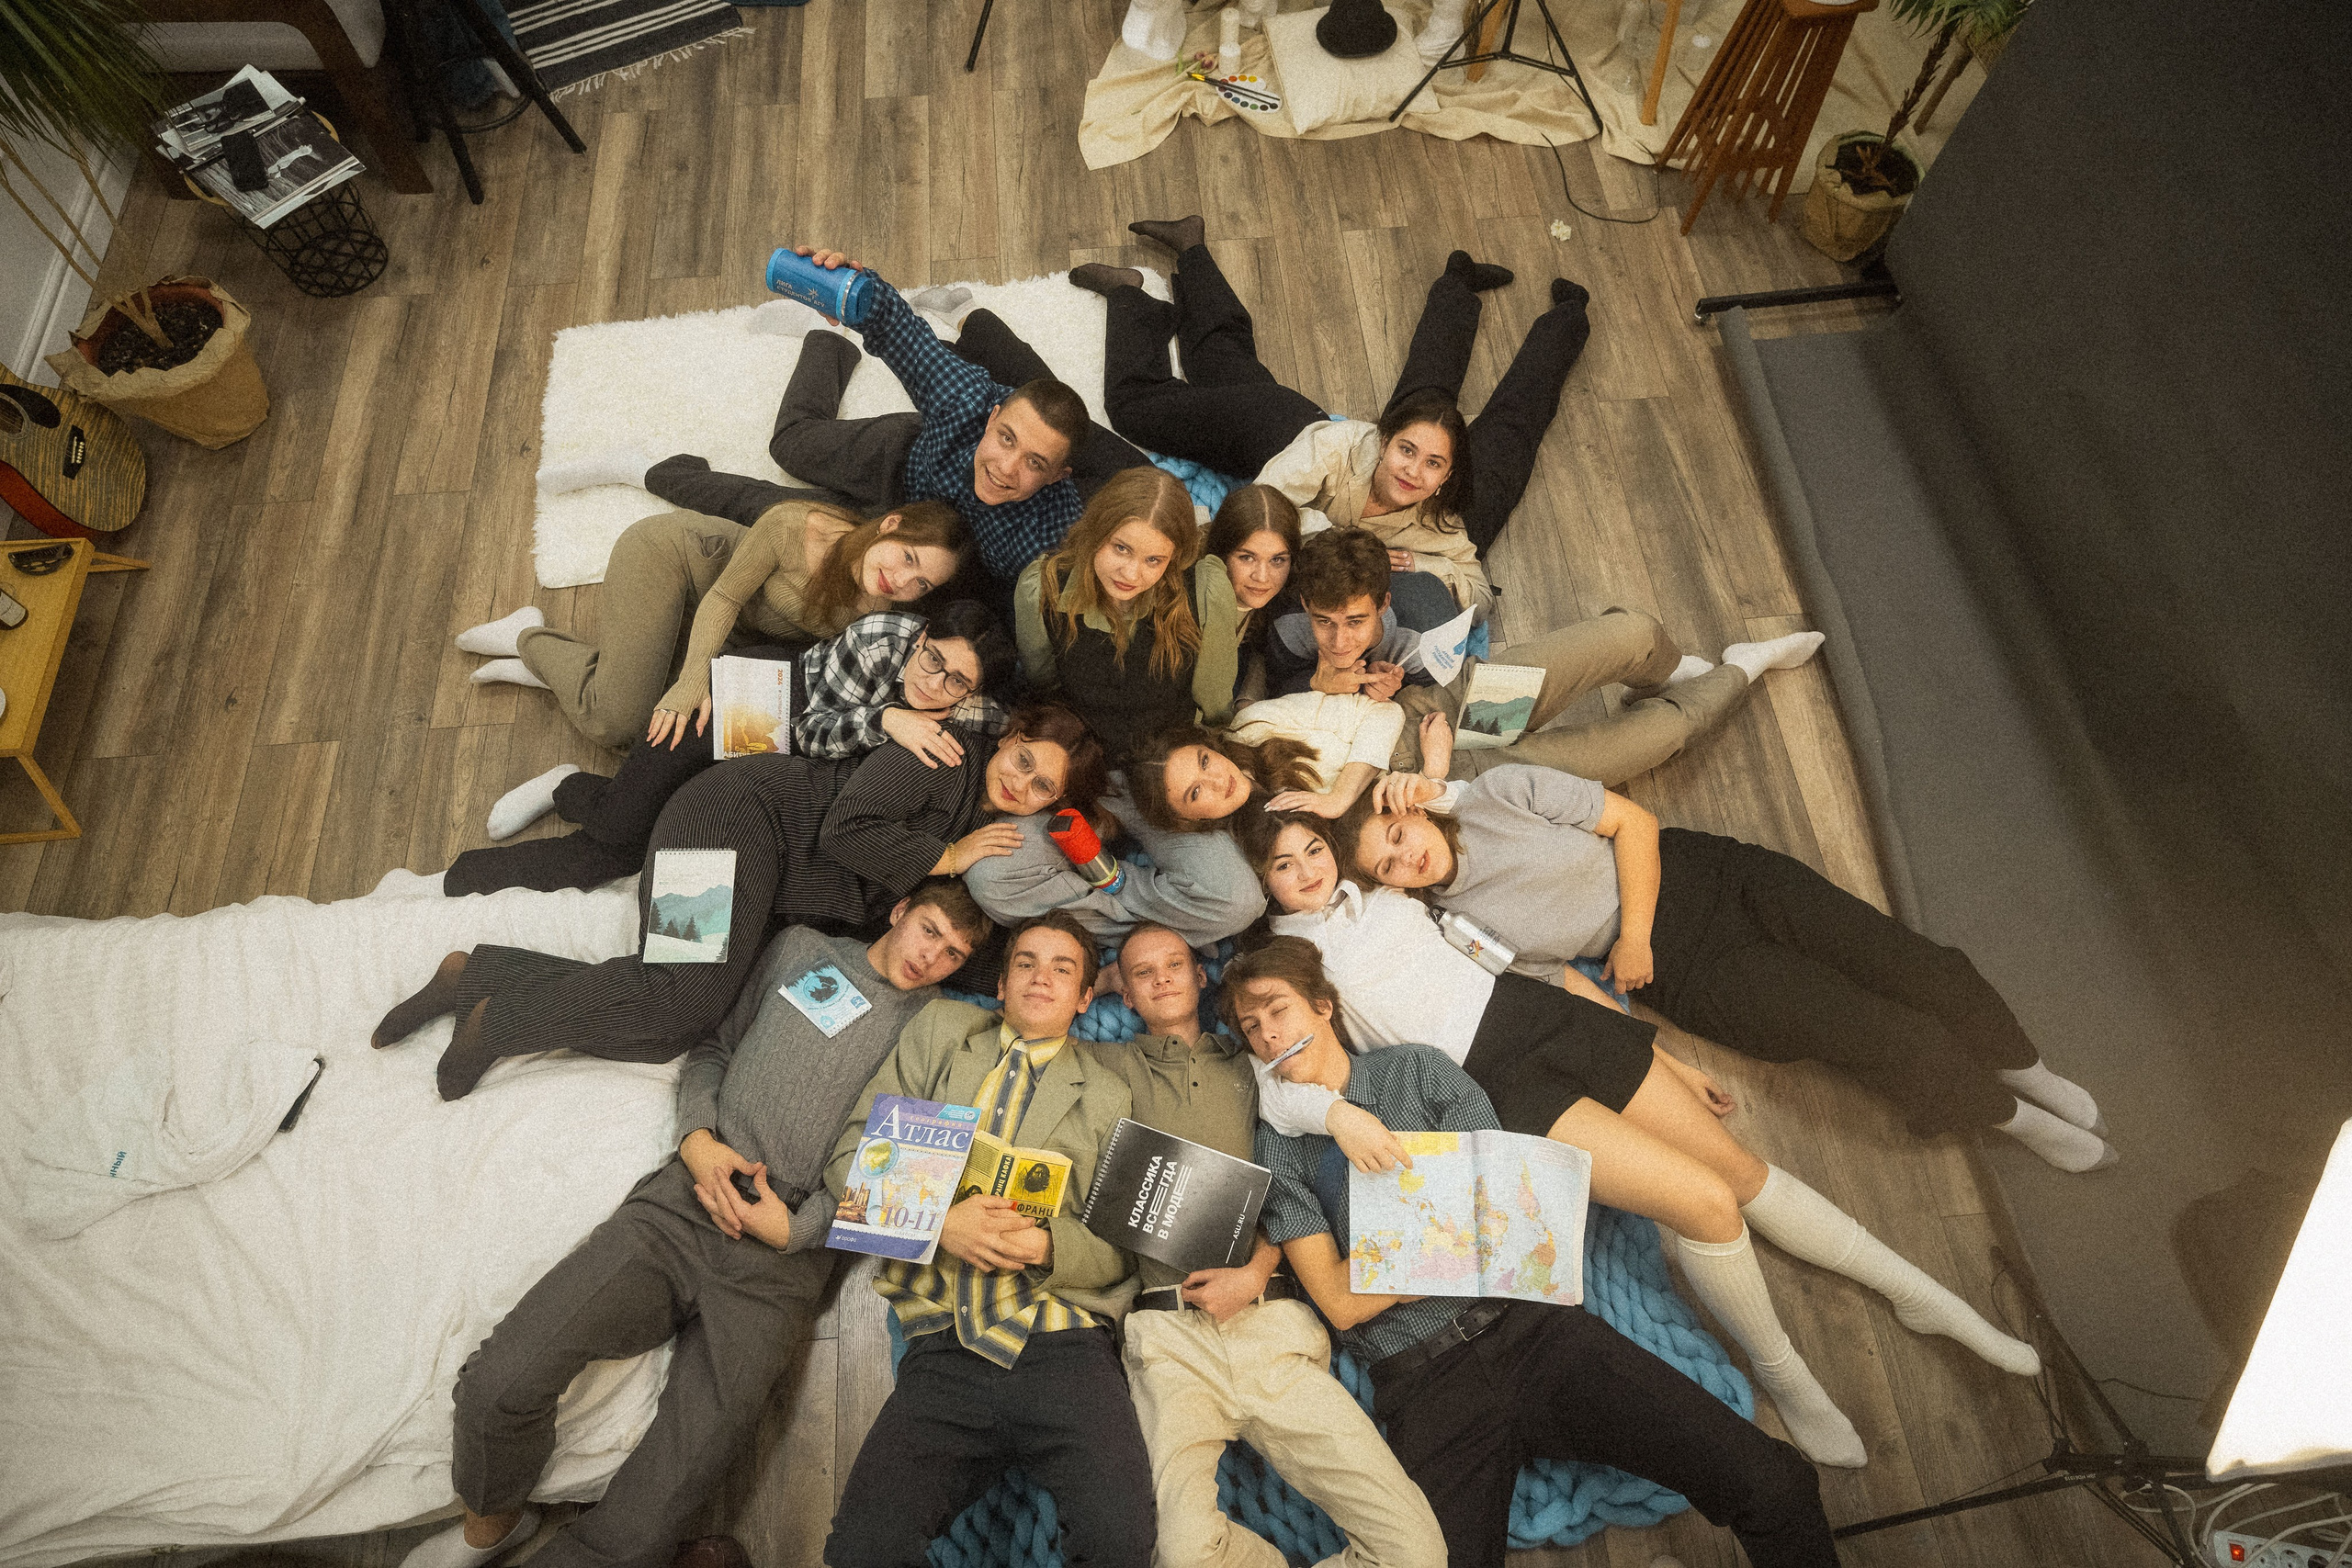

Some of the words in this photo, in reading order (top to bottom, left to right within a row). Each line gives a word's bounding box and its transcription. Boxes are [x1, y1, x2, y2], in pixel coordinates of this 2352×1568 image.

[776, 279, 793, 289] ЛИГА
[870, 1104, 969, 1149] Атлас
[995, 1179, 1006, 1196] РАНЦ
[1001, 1156, 1012, 1179] КАФКА
[1127, 1156, 1163, 1228] КЛАССИКА
[1016, 1203, 1054, 1217] ФРАНЦ
[1142, 1161, 1178, 1235] ВСЕГДА
[1161, 1164, 1193, 1227] МОДЕ
[883, 1205, 937, 1232] 10-11
[1158, 1228, 1169, 1240] В
[1232, 1213, 1246, 1240] ASU.RU
